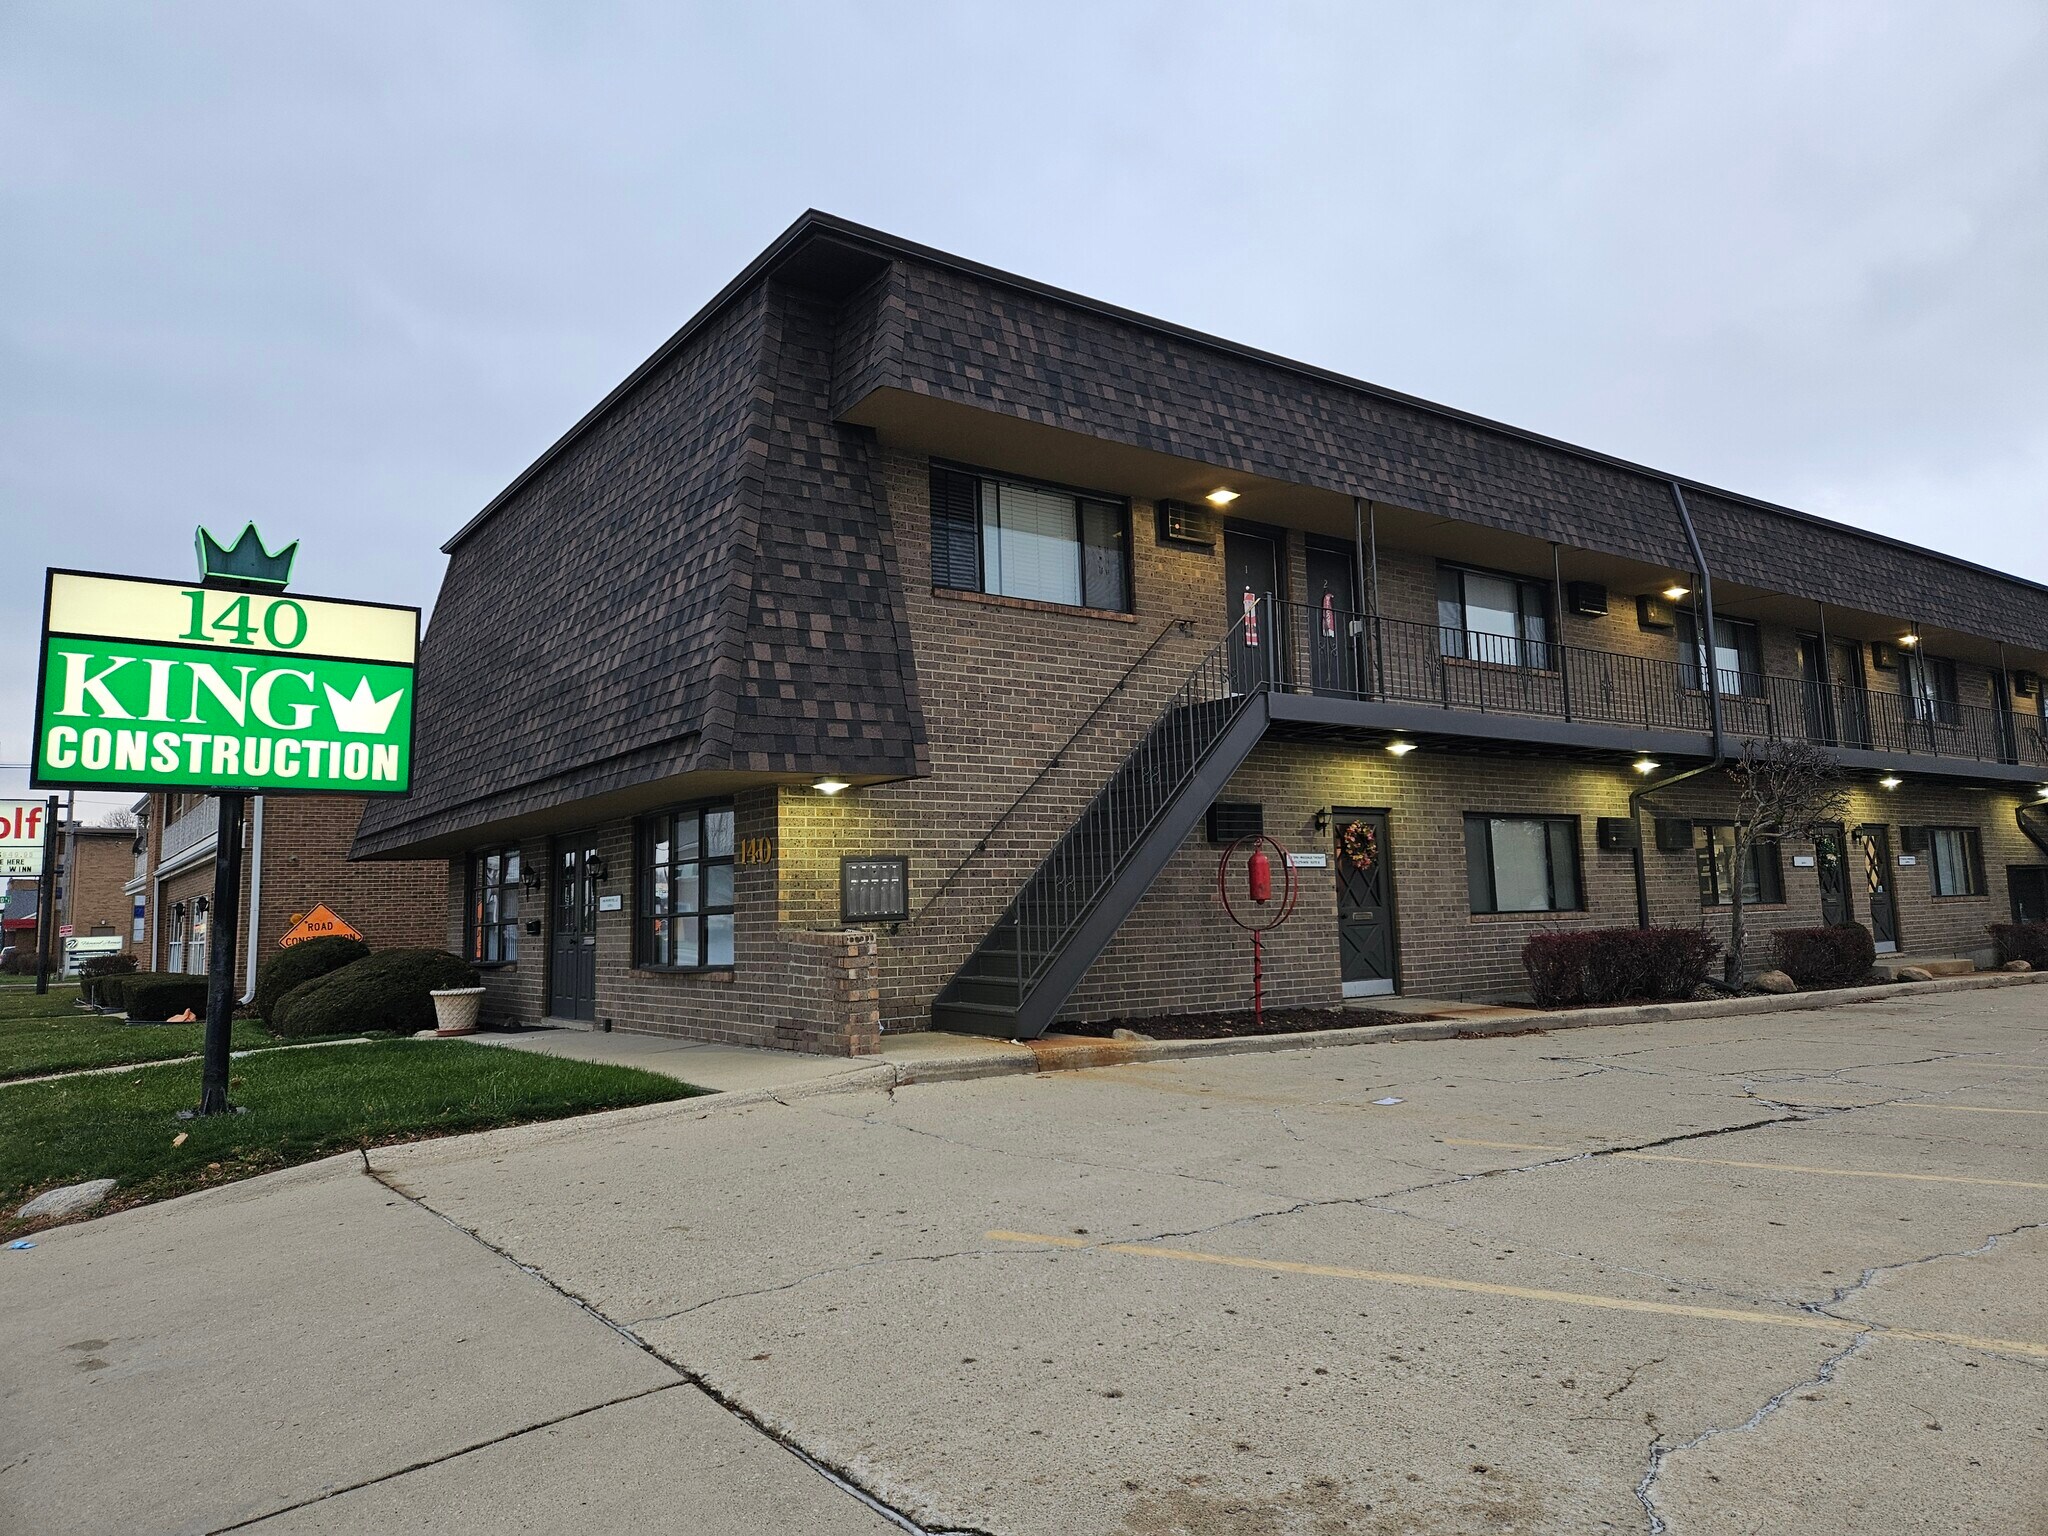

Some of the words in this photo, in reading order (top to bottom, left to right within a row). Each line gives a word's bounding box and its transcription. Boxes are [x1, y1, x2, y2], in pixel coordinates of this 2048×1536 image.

[1323, 579, 1328, 589] 2
[178, 590, 308, 649] 140
[53, 652, 320, 730] KING
[46, 726, 400, 781] CONSTRUCTION
[741, 836, 772, 865] 140
[307, 922, 334, 931] ROAD
